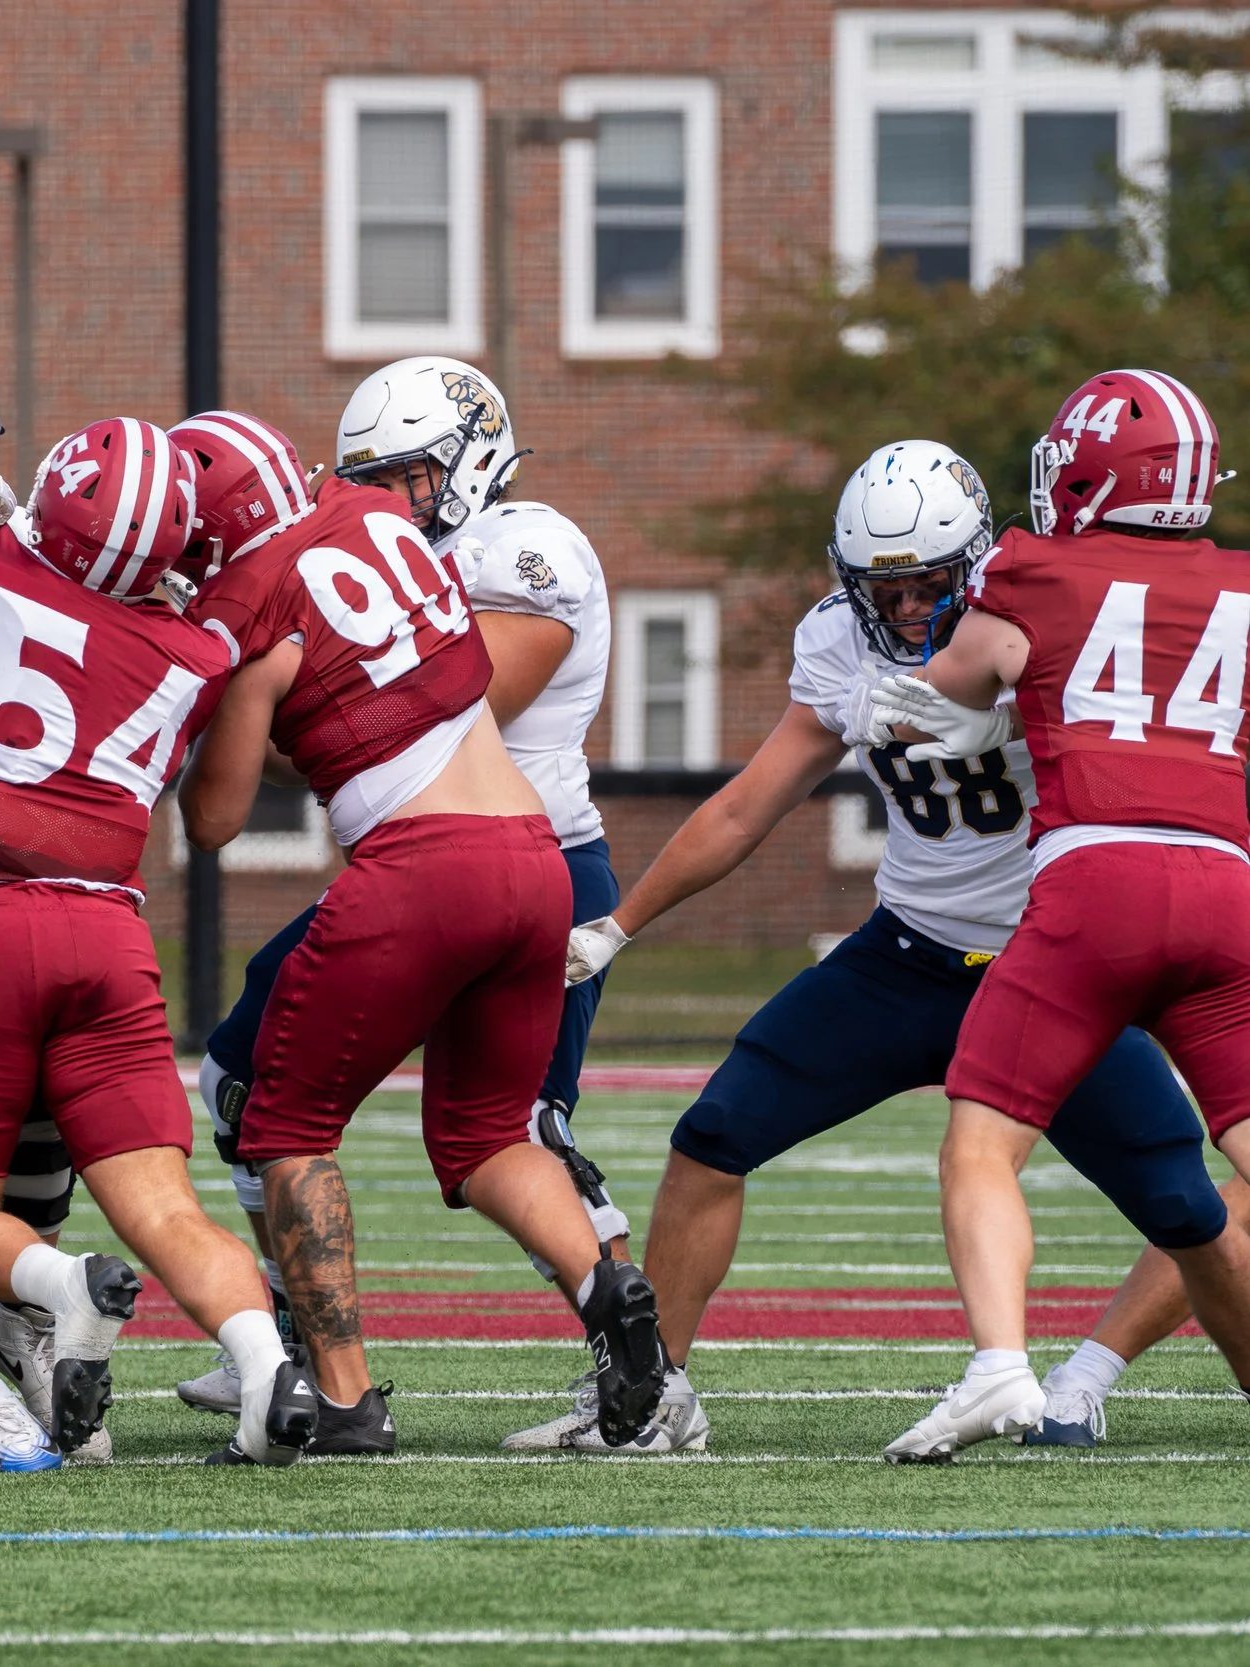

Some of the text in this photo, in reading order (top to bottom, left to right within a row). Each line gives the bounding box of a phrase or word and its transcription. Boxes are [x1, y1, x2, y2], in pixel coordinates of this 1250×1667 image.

[1063, 394, 1127, 444] 44
[50, 432, 101, 499] 54
[1158, 466, 1173, 484] 44
[248, 500, 266, 519] 90
[74, 554, 90, 572] 54
[874, 554, 913, 567] TRINITY
[297, 511, 470, 690] 90
[1063, 580, 1250, 757] 44
[867, 742, 1031, 842] 88
[671, 1404, 687, 1430] ALPHA
